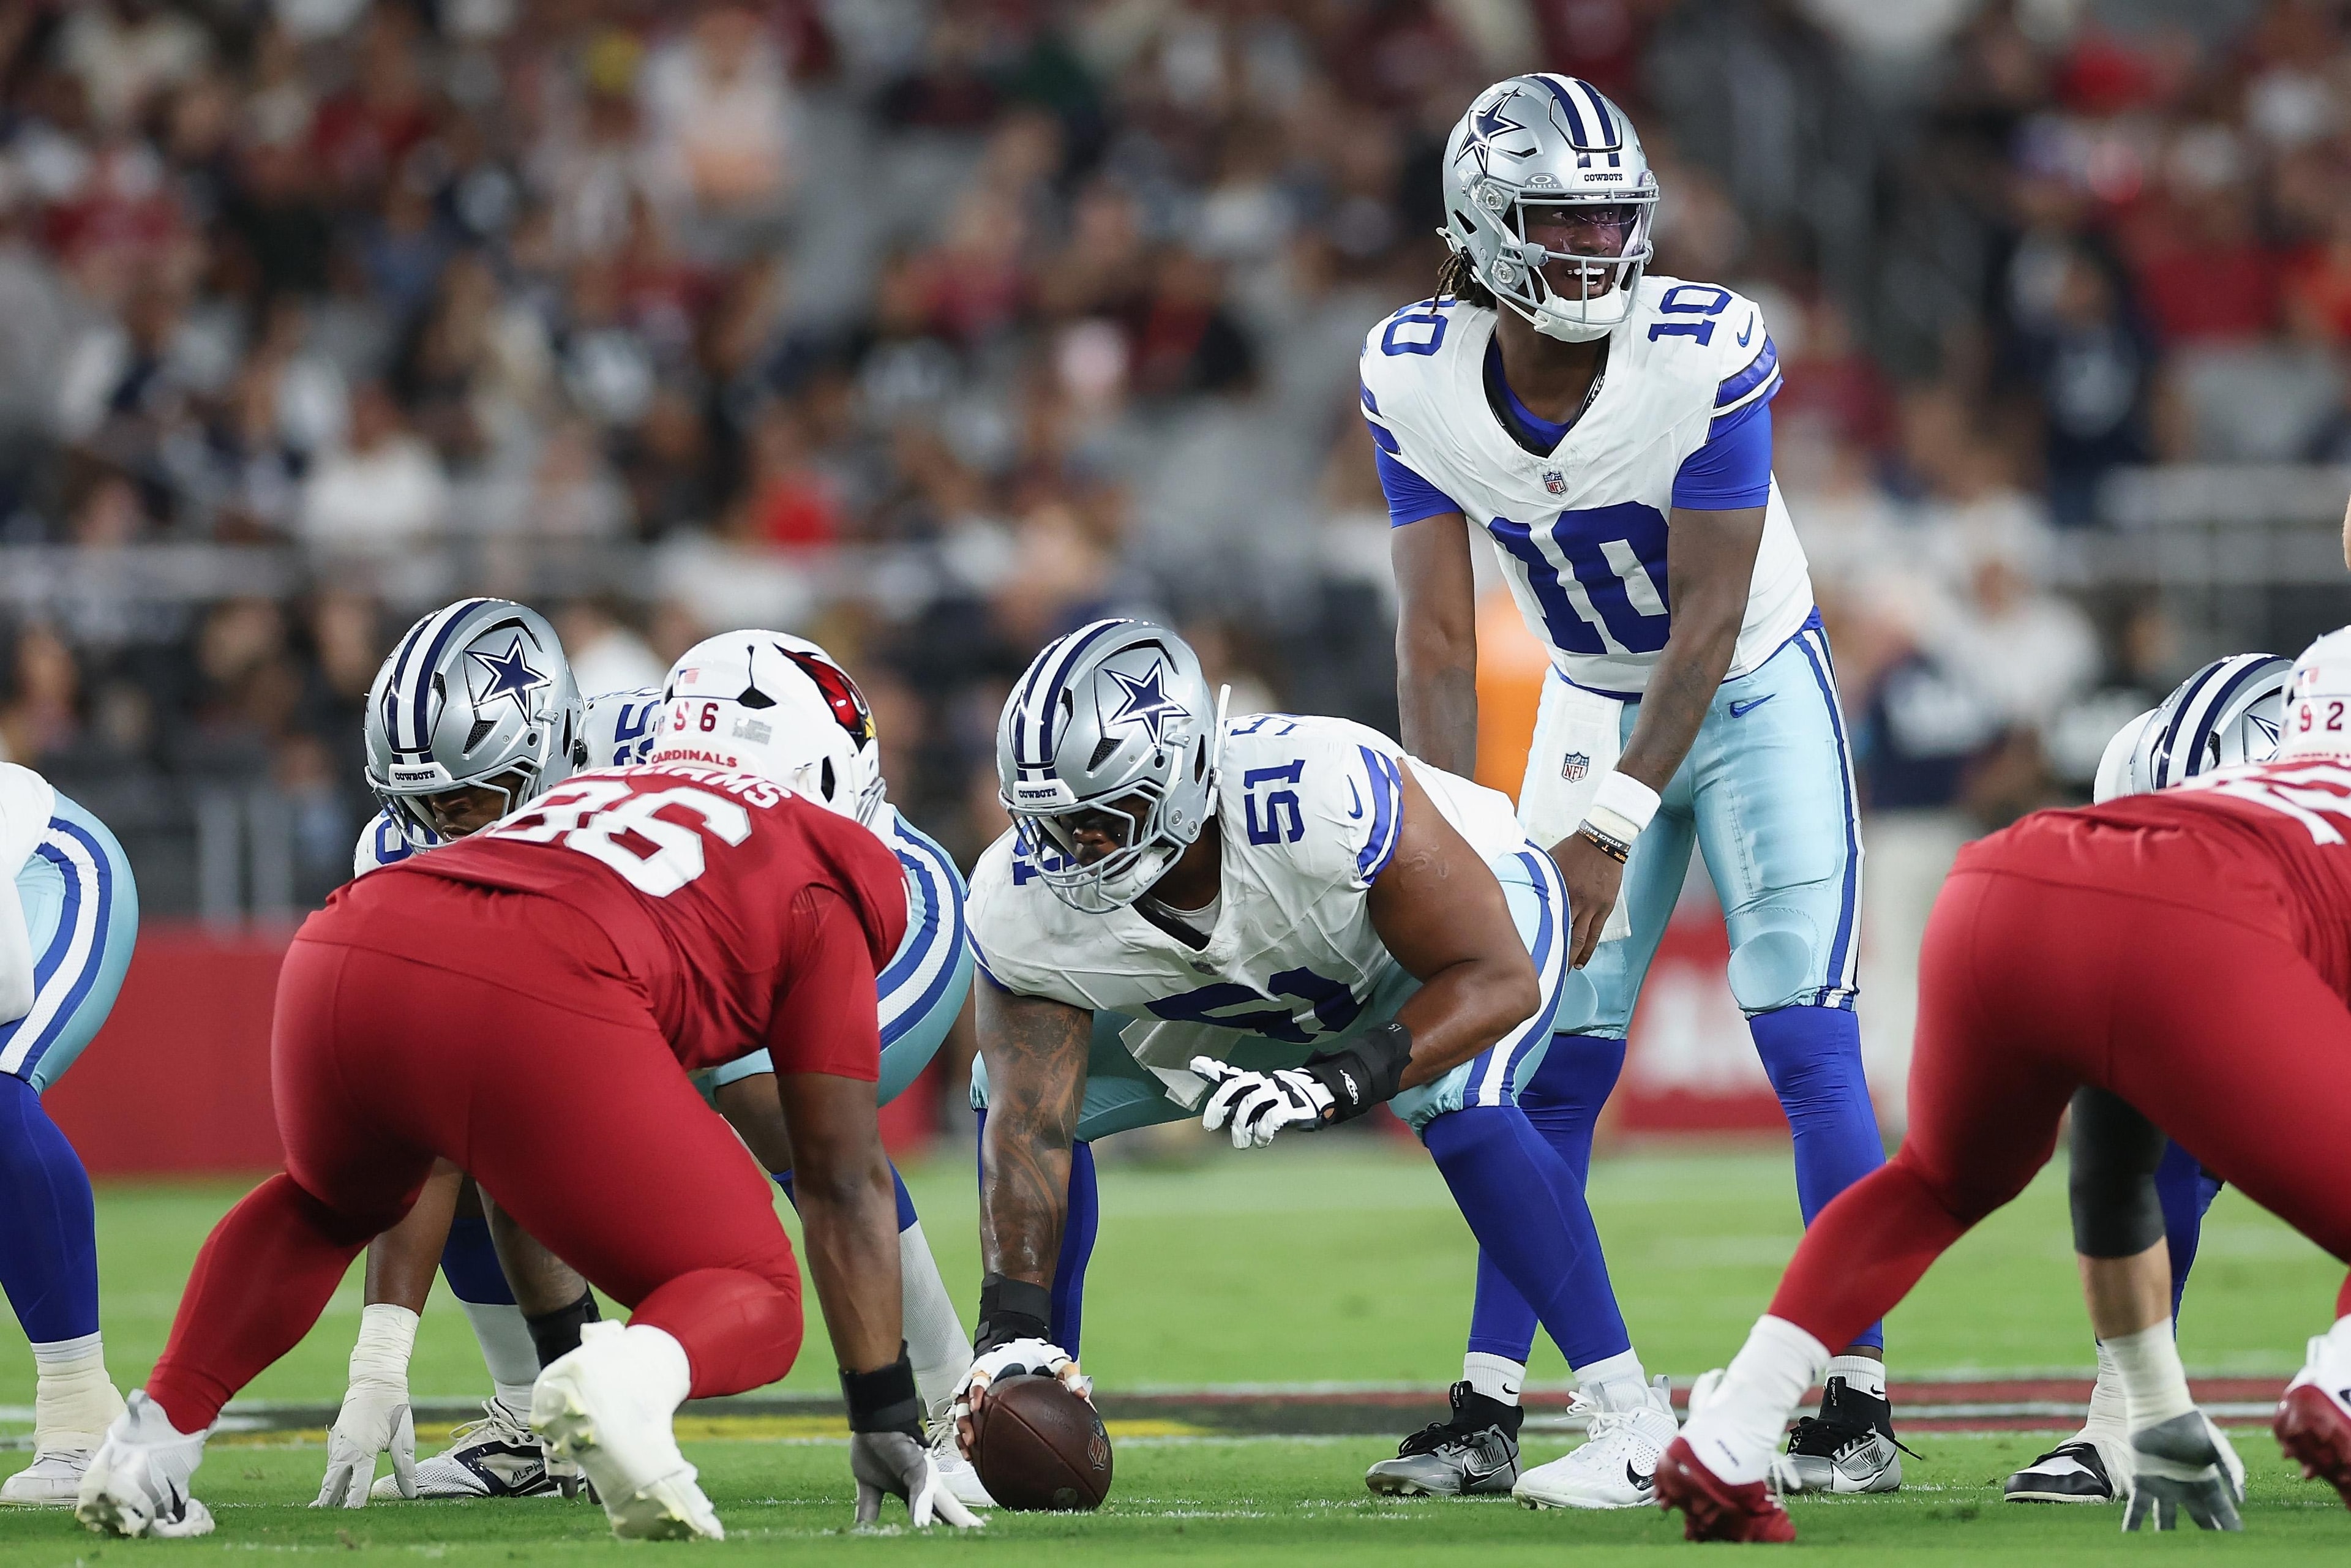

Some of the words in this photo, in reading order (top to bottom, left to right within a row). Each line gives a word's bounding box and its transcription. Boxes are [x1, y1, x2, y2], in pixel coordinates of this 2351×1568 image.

[1584, 173, 1623, 182] COWBOYS
[1648, 285, 1733, 347] 10
[1487, 500, 1671, 655] 10
[2300, 701, 2344, 732] 92
[651, 749, 738, 768] CARDINALS
[394, 770, 436, 781] COWBOYS
[1018, 788, 1058, 798] COWBOYS
[1243, 759, 1306, 846] 51
[1584, 825, 1599, 836] BALL
[1597, 833, 1623, 848] ATTACK
[1388, 1023, 1402, 1032] 51
